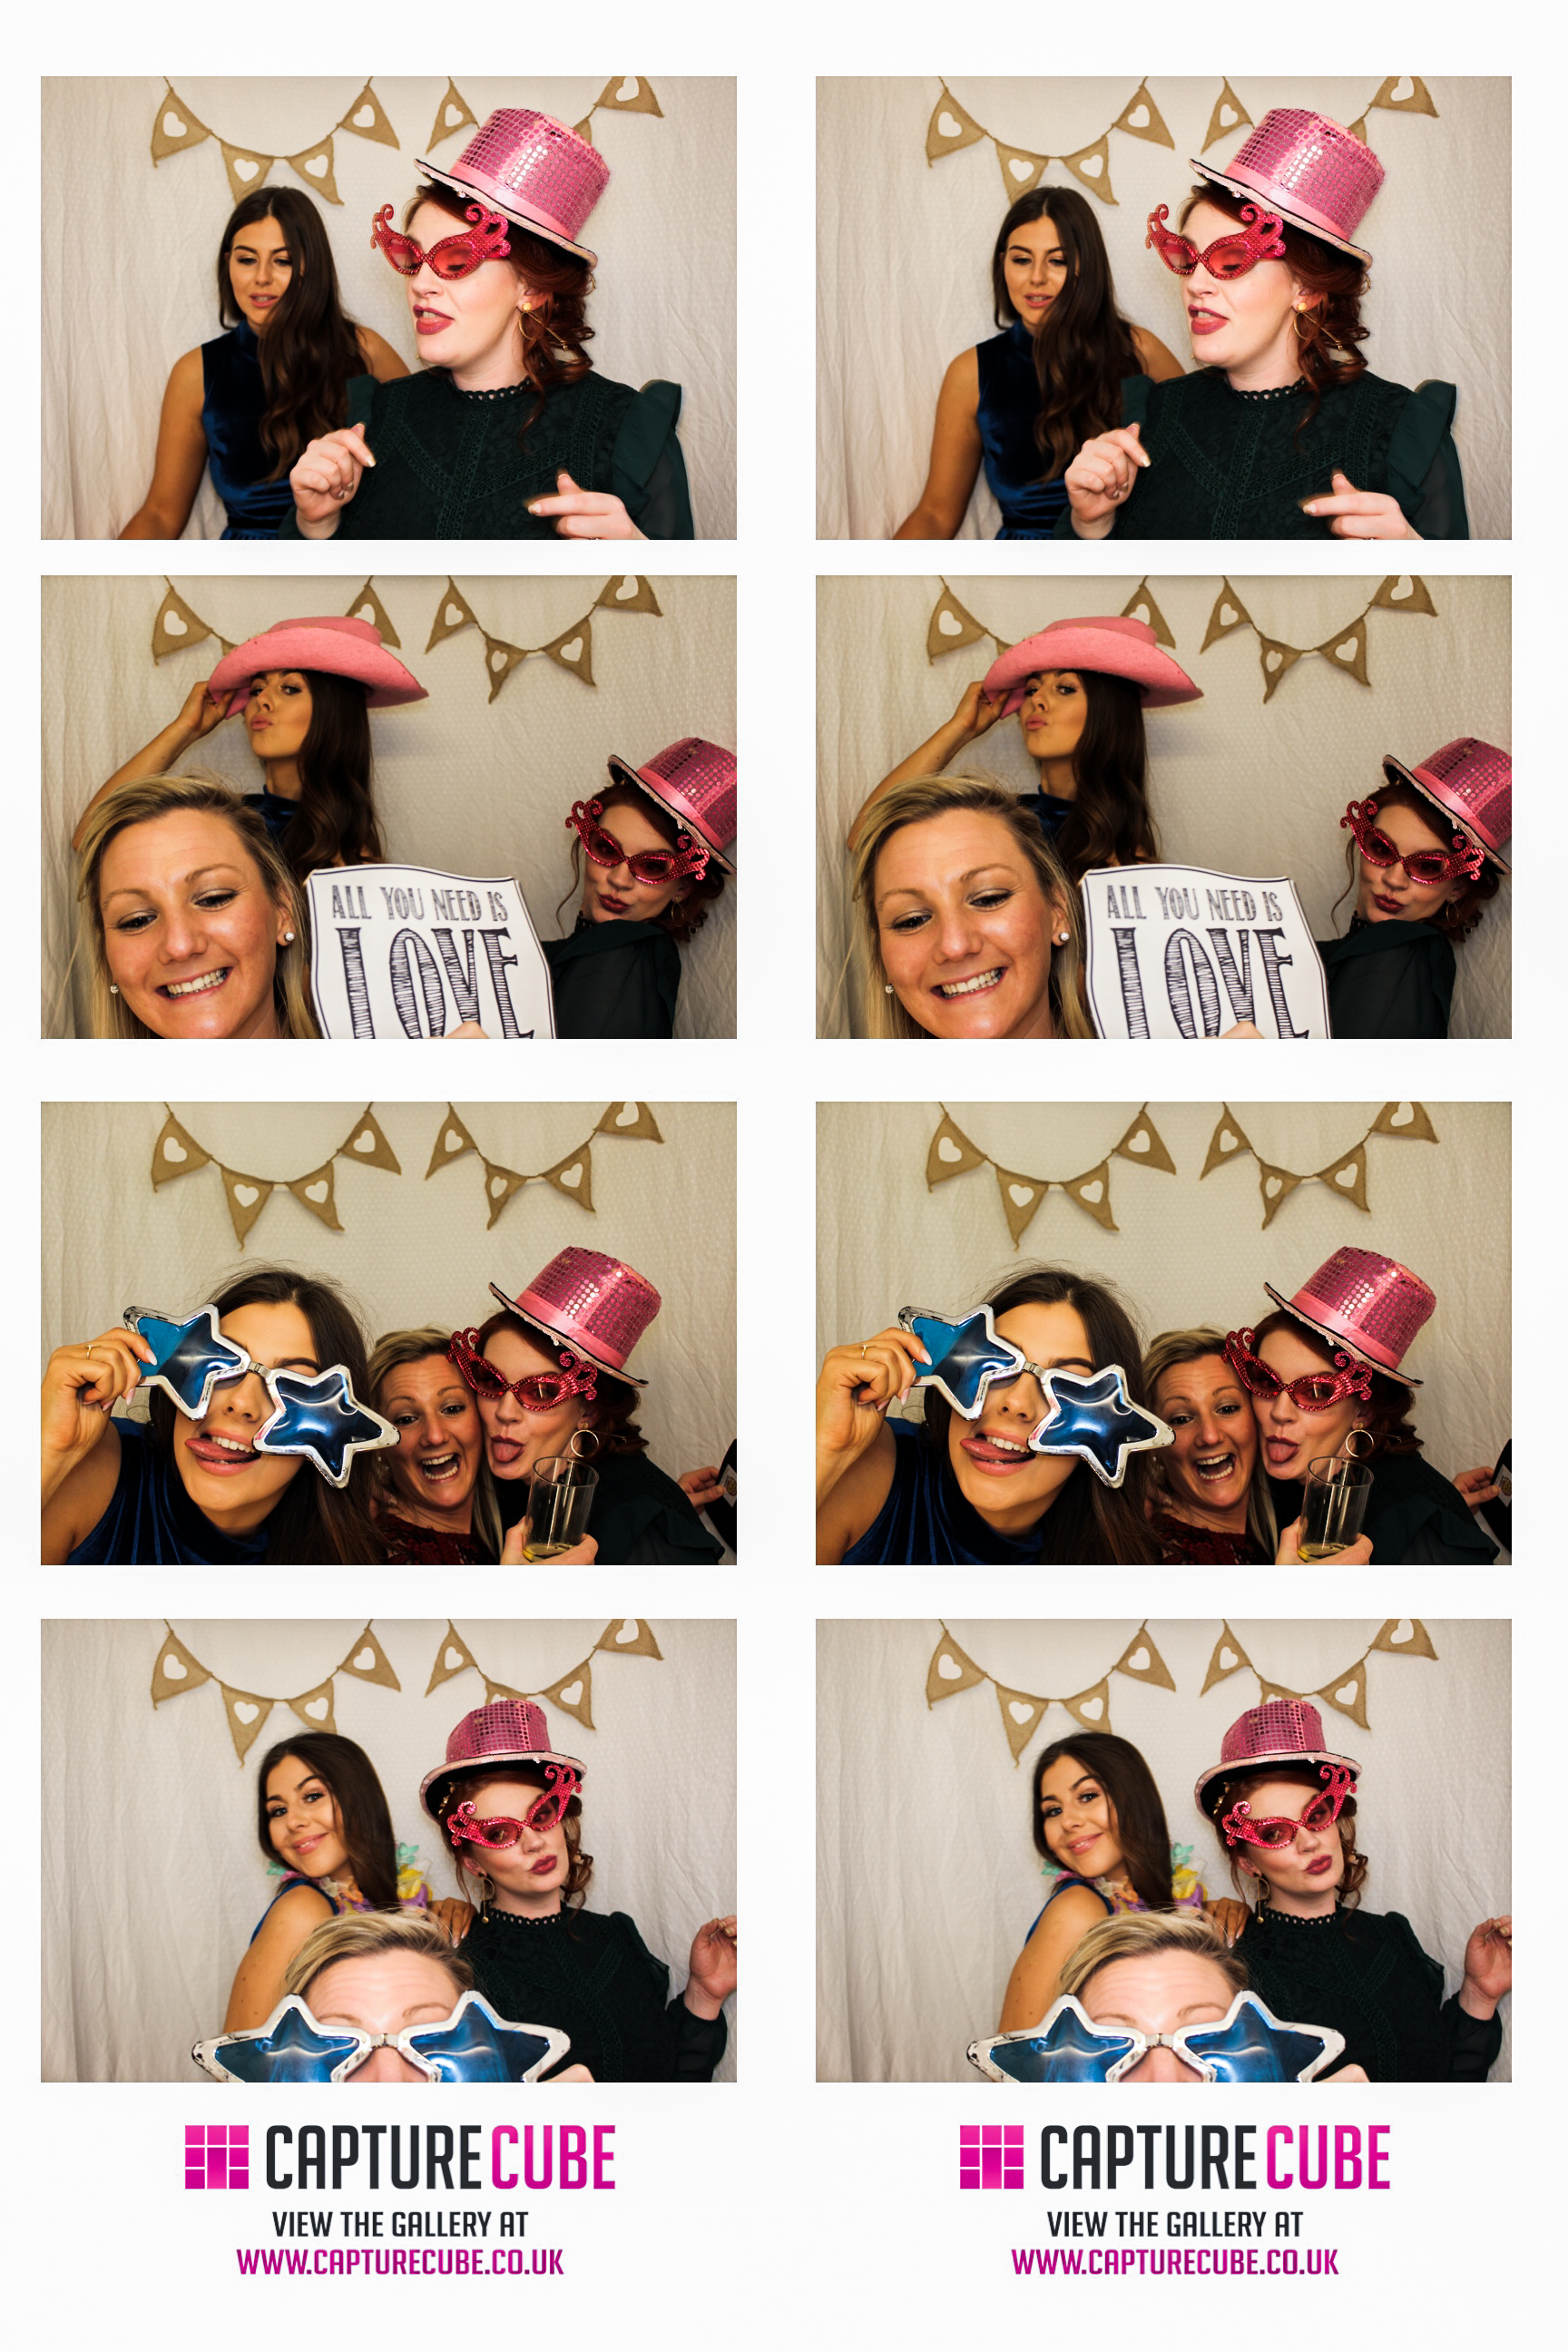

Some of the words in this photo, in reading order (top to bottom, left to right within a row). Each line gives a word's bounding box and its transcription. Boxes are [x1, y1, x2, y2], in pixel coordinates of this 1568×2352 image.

[332, 885, 372, 919] ALL
[379, 887, 425, 920] YOU
[431, 888, 482, 921] NEED
[486, 891, 508, 922] IS
[1107, 885, 1147, 919] ALL
[1154, 887, 1200, 920] YOU
[1206, 888, 1257, 921] NEED
[1261, 891, 1283, 922] IS
